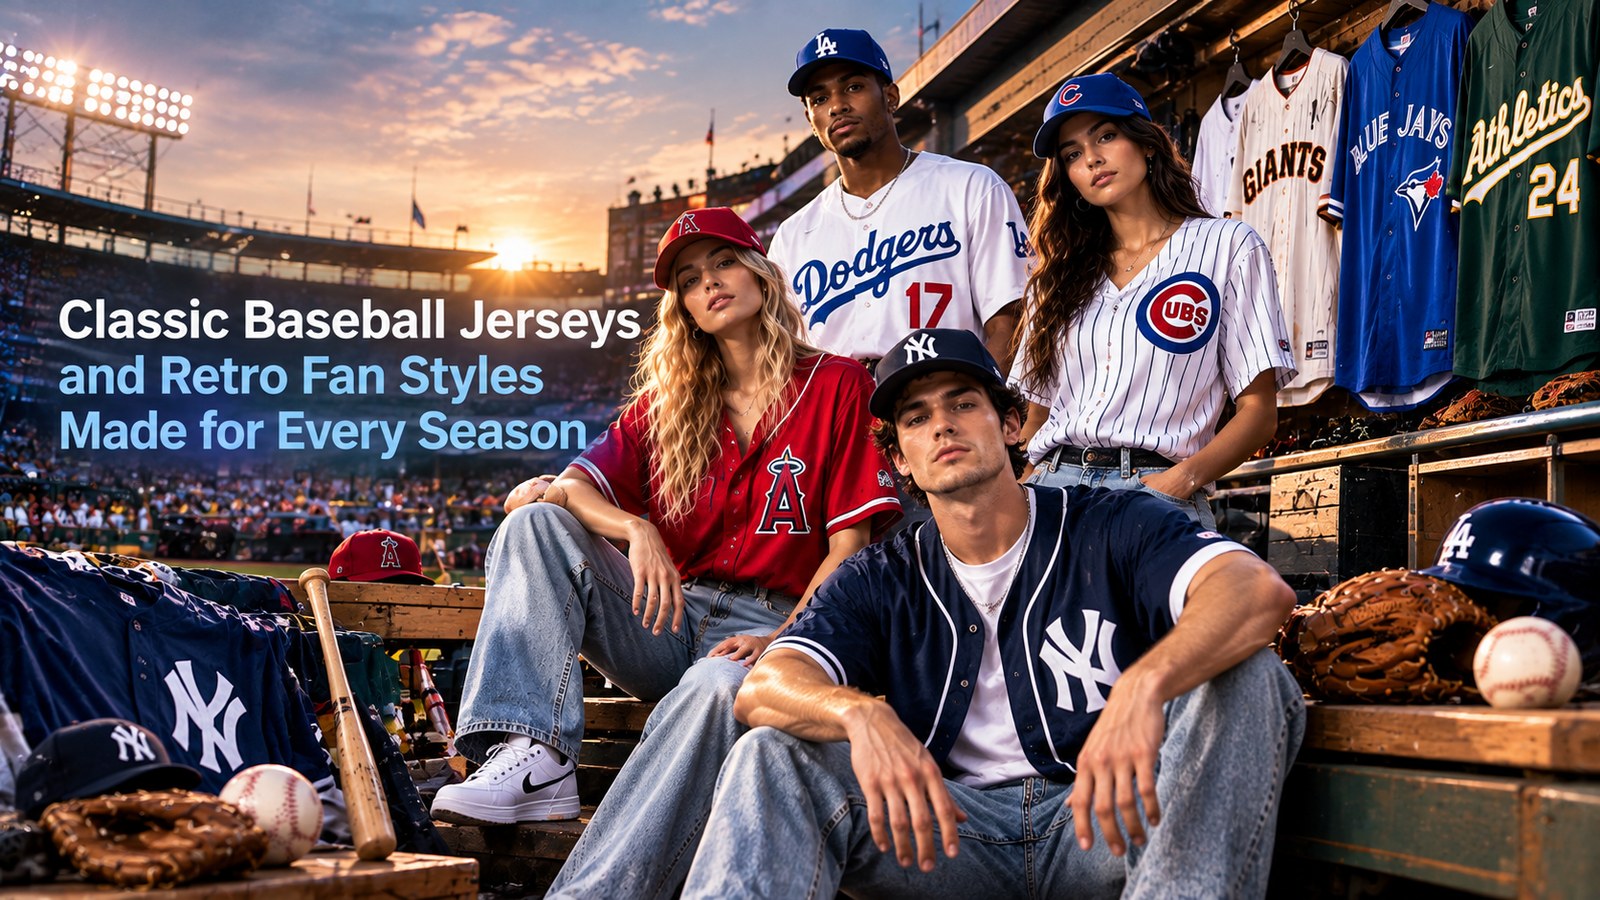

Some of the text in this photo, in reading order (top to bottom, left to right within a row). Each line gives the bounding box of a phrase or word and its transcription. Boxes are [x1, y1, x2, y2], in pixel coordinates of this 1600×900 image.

[815, 33, 838, 58] LA
[1059, 84, 1083, 107] C
[1350, 104, 1452, 175] BLUE JAYS
[1463, 76, 1591, 206] Athletics
[1242, 141, 1327, 206] GIANTS
[1527, 158, 1581, 220] 24
[678, 213, 700, 236] A
[793, 220, 961, 330] Dodgers
[906, 282, 953, 329] 17
[904, 333, 939, 365] NY
[755, 444, 811, 535] A
[381, 536, 401, 568] A
[1438, 513, 1476, 565] LA
[1039, 609, 1122, 714] NY
[111, 725, 156, 761] NY
[164, 660, 247, 773] NY
